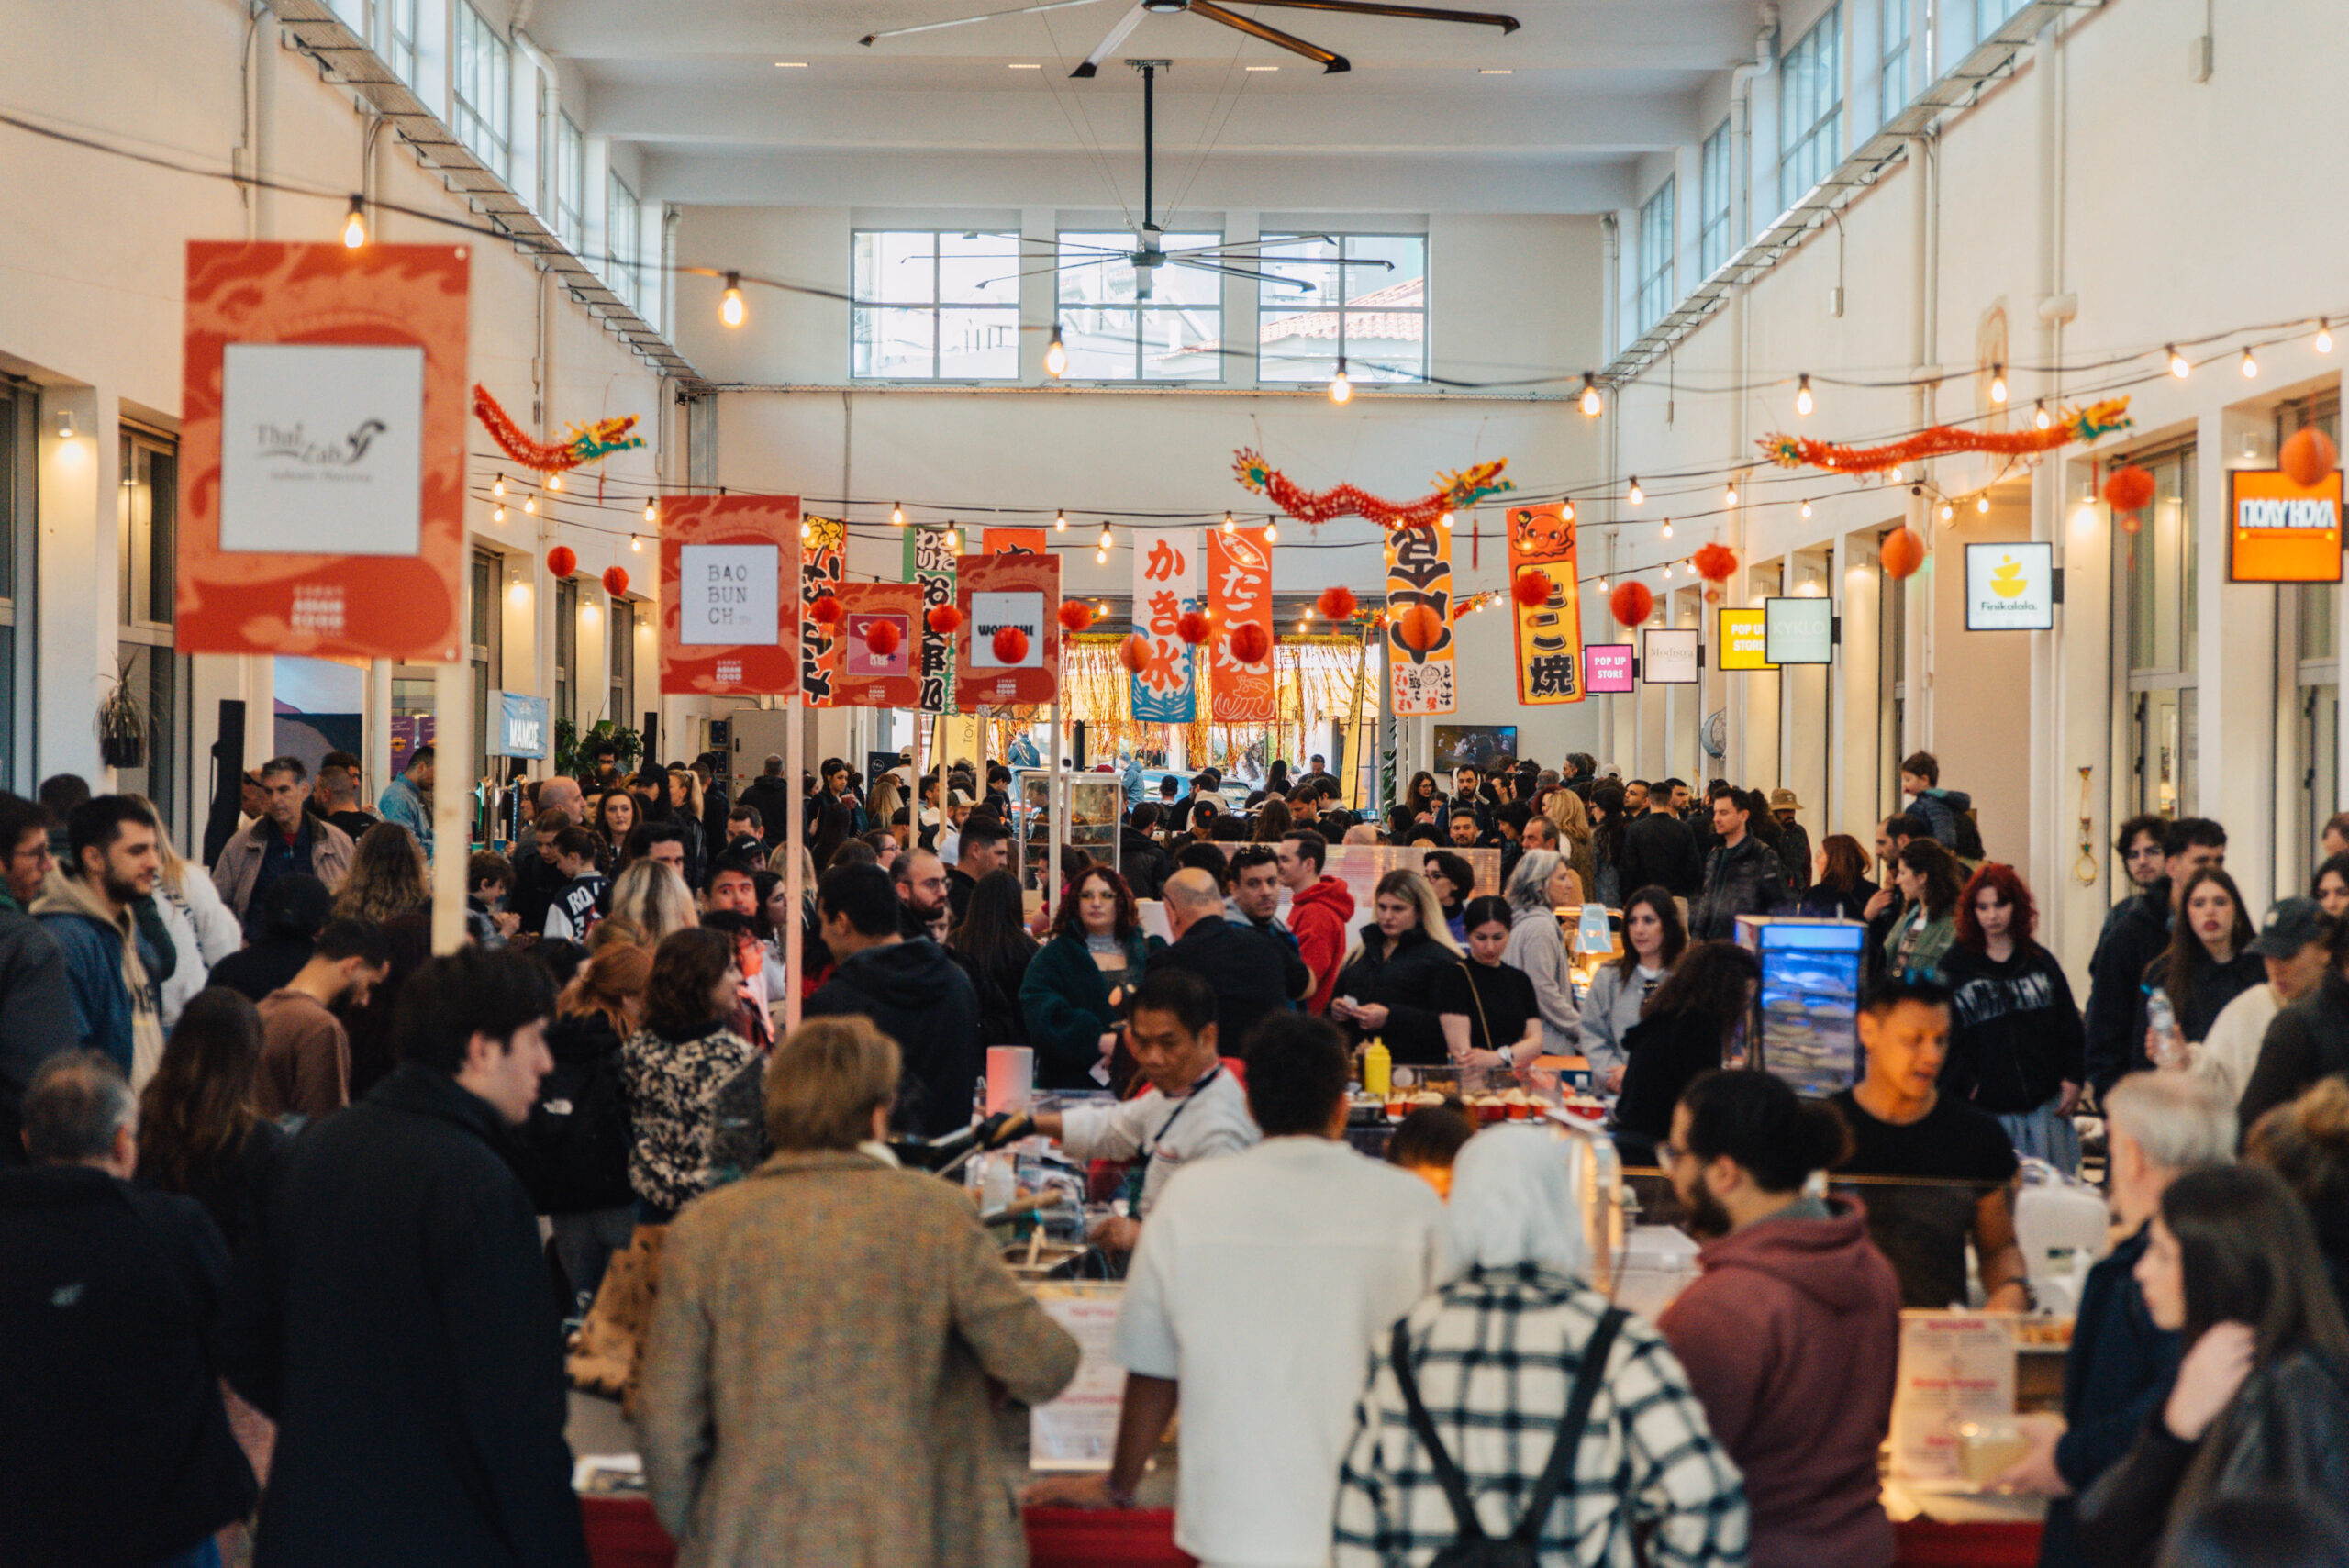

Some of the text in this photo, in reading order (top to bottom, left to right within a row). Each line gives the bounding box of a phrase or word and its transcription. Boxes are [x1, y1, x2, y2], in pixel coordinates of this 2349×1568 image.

[708, 565, 747, 582] BAO
[708, 586, 747, 603] BUN
[708, 607, 734, 625] CH
[1731, 624, 1752, 635] POP
[1733, 639, 1765, 652] STORE
[1651, 648, 1694, 659] Modistra
[1594, 657, 1626, 666] POP UP
[1598, 670, 1623, 680] STORE
